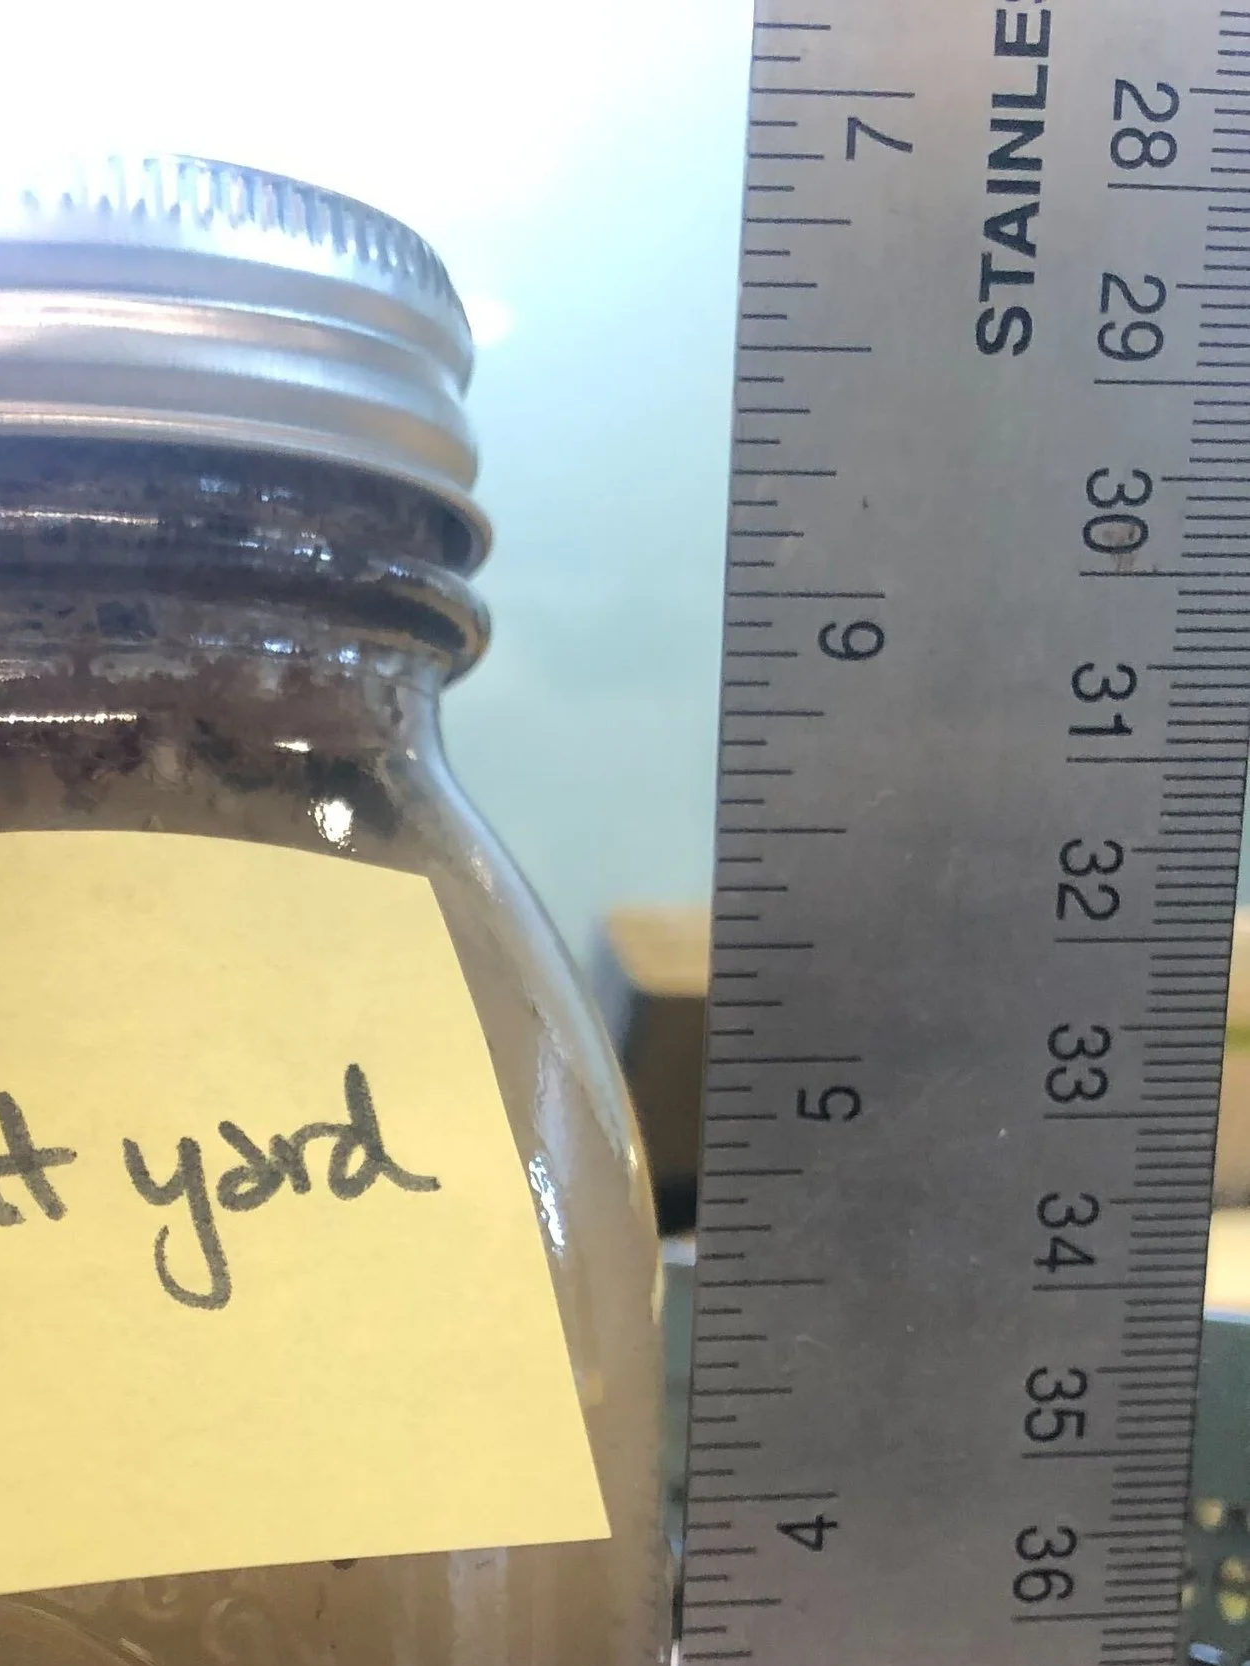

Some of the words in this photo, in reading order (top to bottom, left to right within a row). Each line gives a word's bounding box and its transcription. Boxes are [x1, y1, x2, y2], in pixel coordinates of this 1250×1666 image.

[845, 116, 913, 160] 7
[1110, 78, 1180, 170] 28
[975, 0, 1052, 357] STAINLE
[1097, 272, 1167, 362] 29
[1082, 467, 1153, 556] 30
[817, 620, 885, 662] 6
[1068, 662, 1138, 737] 31
[1056, 838, 1124, 921] 32
[796, 1085, 862, 1122] 5
[1045, 1023, 1112, 1104] 33
[122, 1062, 442, 1311] yard
[1033, 1192, 1100, 1273] 34
[1024, 1366, 1089, 1443] 35
[776, 1514, 839, 1552] 4
[1012, 1525, 1078, 1604] 36
